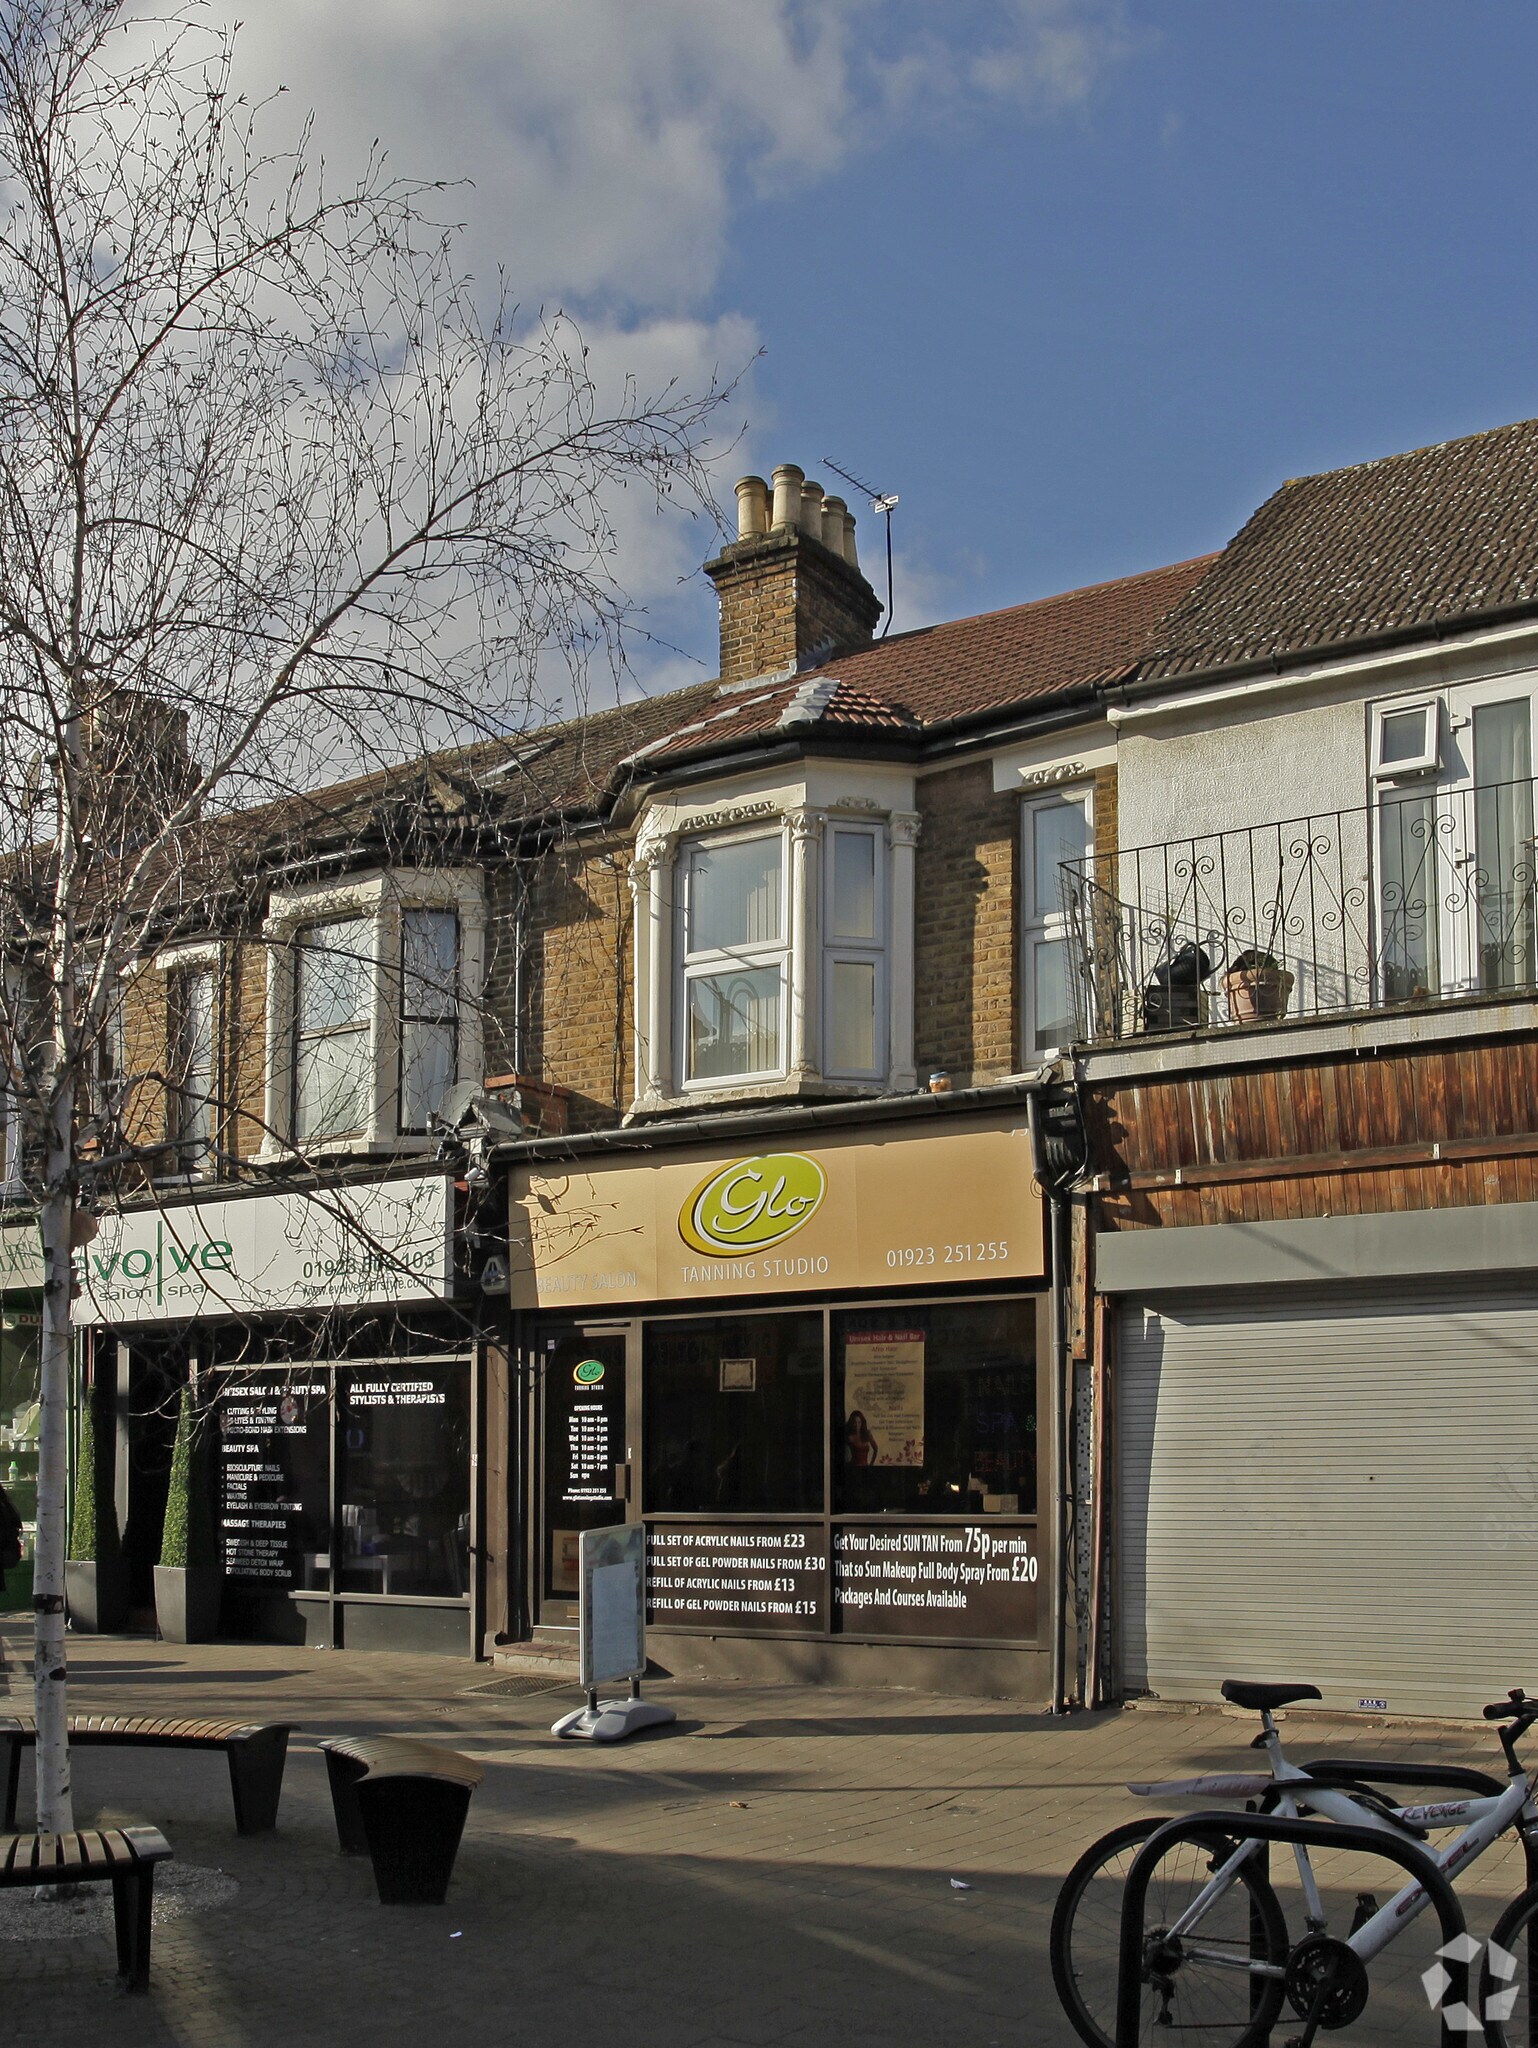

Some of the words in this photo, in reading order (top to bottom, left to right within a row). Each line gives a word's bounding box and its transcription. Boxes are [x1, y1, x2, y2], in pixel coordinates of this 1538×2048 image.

[712, 1168, 815, 1233] Glo
[886, 1247, 935, 1267] 01923
[944, 1244, 972, 1263] 251
[977, 1241, 1008, 1261] 255
[681, 1261, 756, 1283] TANNING
[763, 1256, 830, 1277] STUDIO
[99, 1284, 153, 1302] salon
[167, 1282, 205, 1297] spa
[536, 1273, 588, 1294] BEAUTY
[591, 1271, 637, 1289] SALON
[310, 1385, 327, 1395] SPA
[350, 1383, 364, 1394] ALL
[365, 1383, 390, 1393] FULLY
[390, 1382, 434, 1392] CERTIFIED
[350, 1395, 387, 1405] STYLISTS
[387, 1395, 395, 1405] &
[395, 1393, 445, 1404] THERAPISTS
[646, 1535, 665, 1546] FULL
[667, 1535, 682, 1546] SET
[682, 1535, 694, 1546] OF
[695, 1535, 729, 1547] ACRYLIC
[730, 1536, 755, 1547] NAILS
[756, 1536, 782, 1548] FROM
[783, 1534, 806, 1548] £23
[834, 1534, 849, 1551] Get
[848, 1534, 869, 1551] Your
[869, 1534, 901, 1552] Desired
[902, 1534, 921, 1552] SUN
[922, 1535, 939, 1552] TAN
[940, 1535, 963, 1553] From
[964, 1527, 990, 1560] 75p
[992, 1539, 1008, 1558] per
[1009, 1536, 1027, 1554] min
[646, 1556, 666, 1567] FULL
[667, 1556, 682, 1567] SET
[682, 1557, 694, 1568] OF
[695, 1557, 711, 1568] GEL
[712, 1557, 749, 1569] POWDER
[750, 1558, 776, 1570] NAILS
[777, 1559, 803, 1570] FROM
[804, 1557, 826, 1571] £30
[834, 1560, 854, 1577] That
[854, 1564, 864, 1577] so
[865, 1561, 881, 1578] Sun
[882, 1562, 917, 1583] Makeup
[918, 1562, 935, 1580] Full
[936, 1562, 959, 1584] Body
[959, 1563, 985, 1585] Spray
[986, 1563, 1010, 1581] From
[1011, 1556, 1038, 1582] £20
[646, 1577, 673, 1588] REFILL
[674, 1577, 686, 1589] OF
[686, 1578, 720, 1590] ACRYLIC
[721, 1579, 746, 1590] NAILS
[747, 1580, 773, 1591] FROM
[774, 1578, 795, 1592] £13
[646, 1598, 673, 1609] REFILL
[674, 1598, 686, 1610] OF
[686, 1599, 702, 1610] GEL
[703, 1600, 740, 1612] POWDER
[741, 1601, 767, 1613] NAILS
[768, 1602, 793, 1614] FROM
[795, 1600, 817, 1615] £15
[834, 1587, 873, 1609] Packages
[874, 1588, 891, 1606] And
[892, 1589, 925, 1607] Courses
[926, 1590, 967, 1609] Available
[1401, 1801, 1471, 1820] REVENGE
